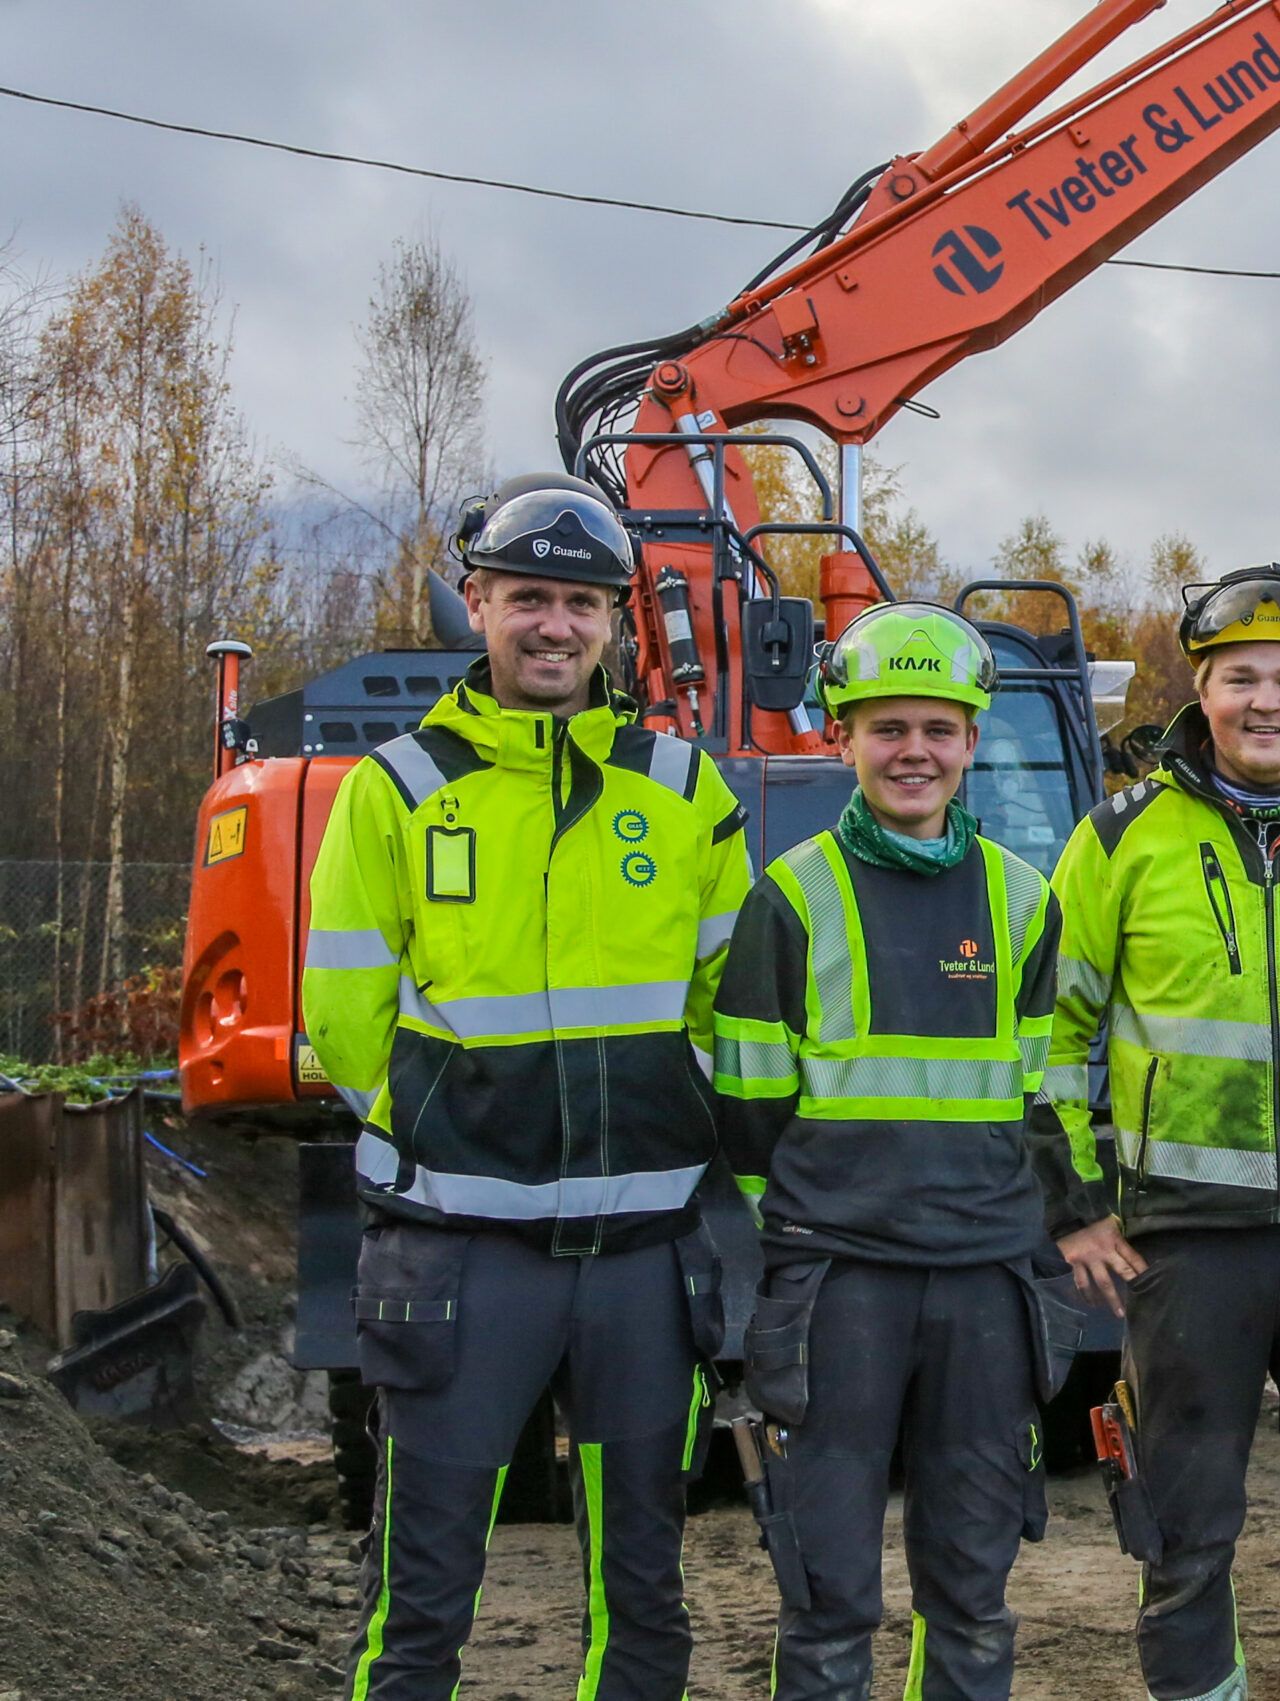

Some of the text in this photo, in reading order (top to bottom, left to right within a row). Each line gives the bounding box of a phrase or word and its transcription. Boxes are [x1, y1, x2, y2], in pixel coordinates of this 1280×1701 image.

[1006, 134, 1147, 241] Tveter
[1142, 103, 1194, 153] &
[553, 545, 592, 560] Guardio
[889, 657, 941, 672] KASK
[939, 960, 995, 973] Tveter & Lund
[302, 1072, 328, 1081] HOL
